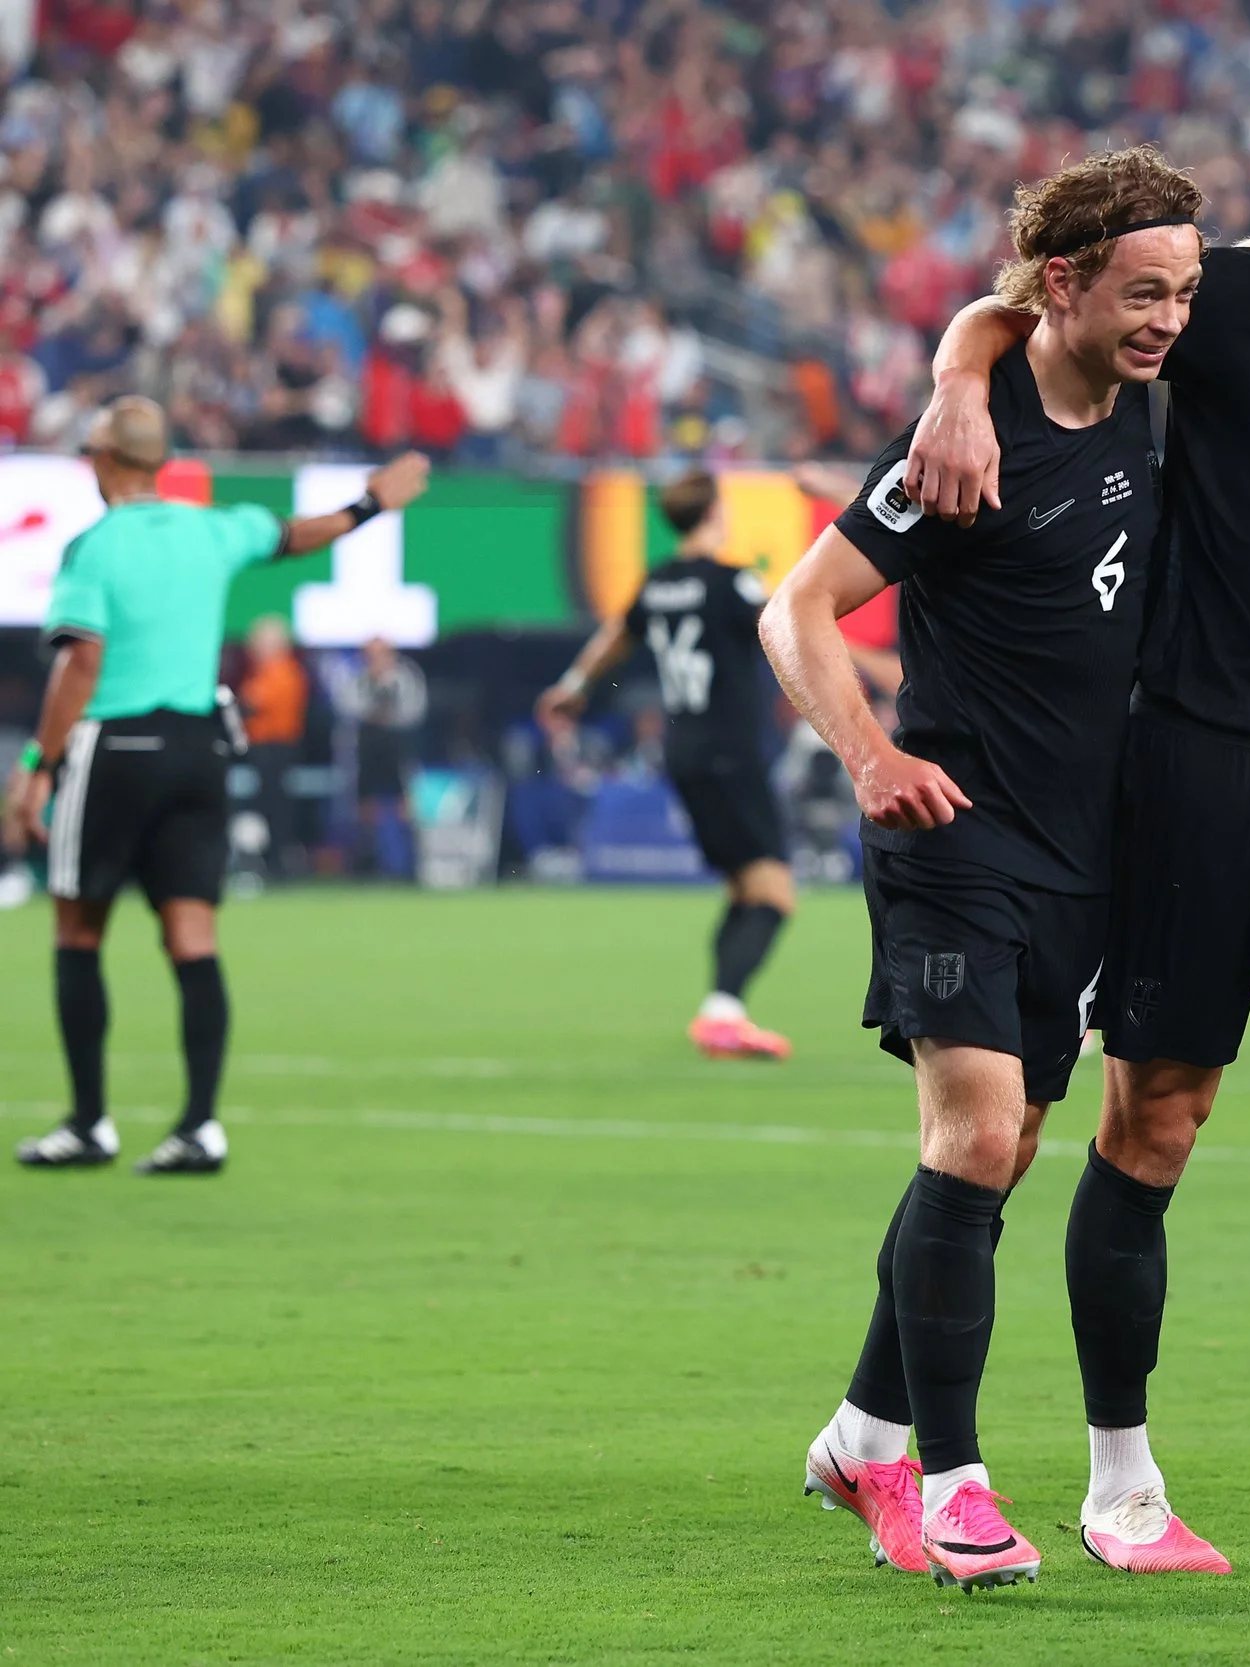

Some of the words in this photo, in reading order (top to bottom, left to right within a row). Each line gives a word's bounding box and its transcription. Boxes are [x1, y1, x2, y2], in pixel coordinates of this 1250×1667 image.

[890, 498, 901, 509] FIFA
[875, 505, 897, 524] 2026
[1091, 530, 1128, 612] 6
